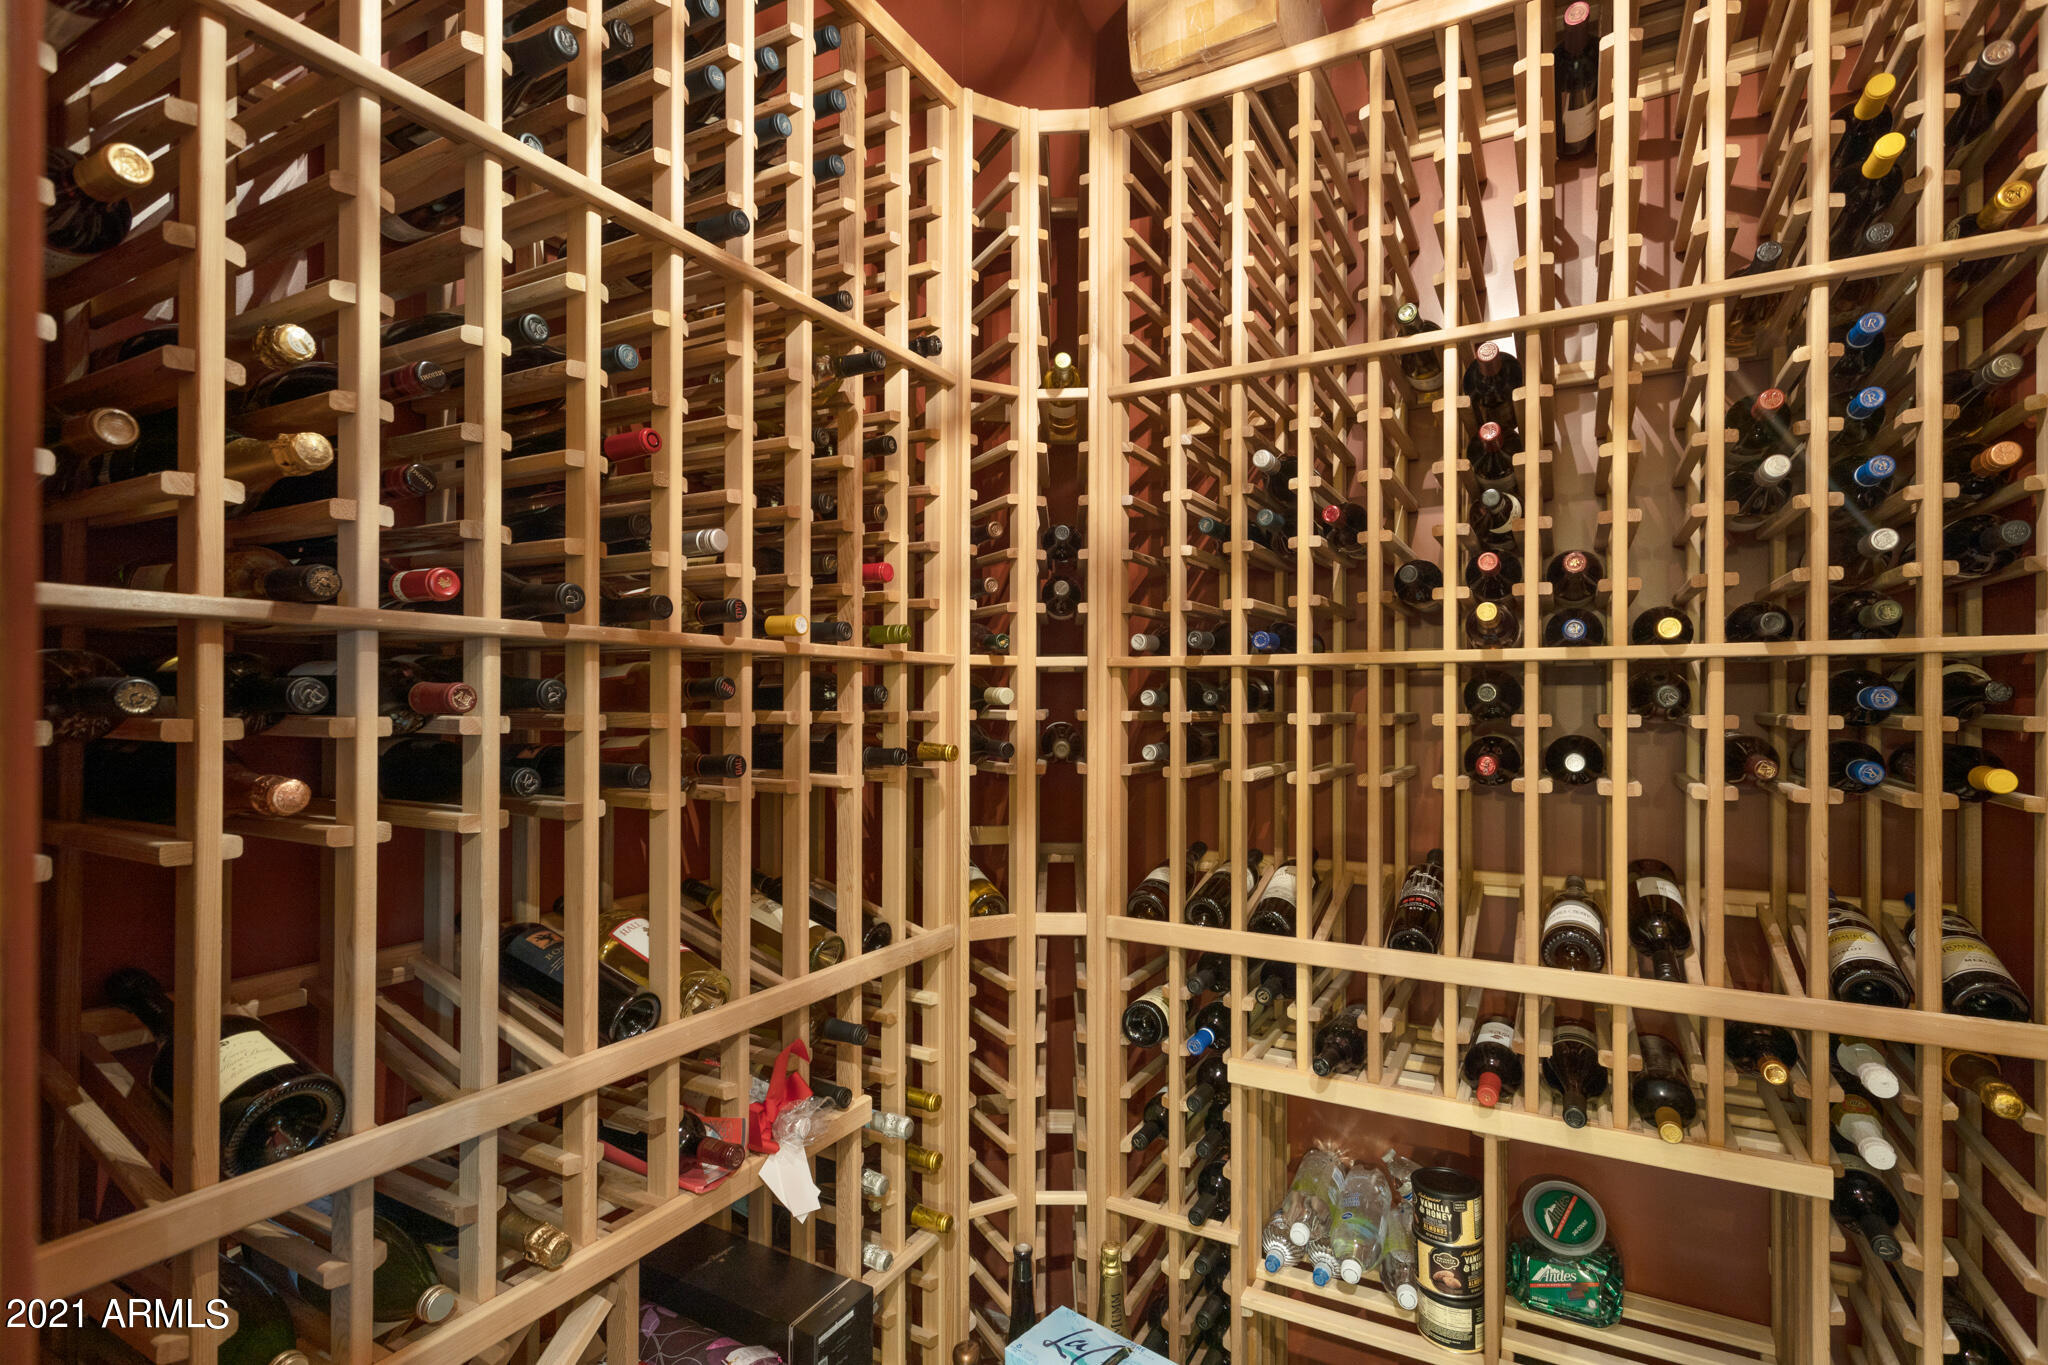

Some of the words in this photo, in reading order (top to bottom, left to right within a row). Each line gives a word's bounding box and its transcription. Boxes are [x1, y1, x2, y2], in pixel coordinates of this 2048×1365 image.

[419, 369, 446, 382] MEIOMI
[409, 465, 435, 490] MEIOMI
[619, 921, 642, 937] HALL
[1420, 1198, 1450, 1213] VANILLA
[1425, 1208, 1452, 1221] HONEY
[1423, 1222, 1448, 1236] ALMONDS
[1463, 1264, 1470, 1272] &
[1538, 1267, 1577, 1282] Andes
[1111, 1293, 1121, 1334] MUMM
